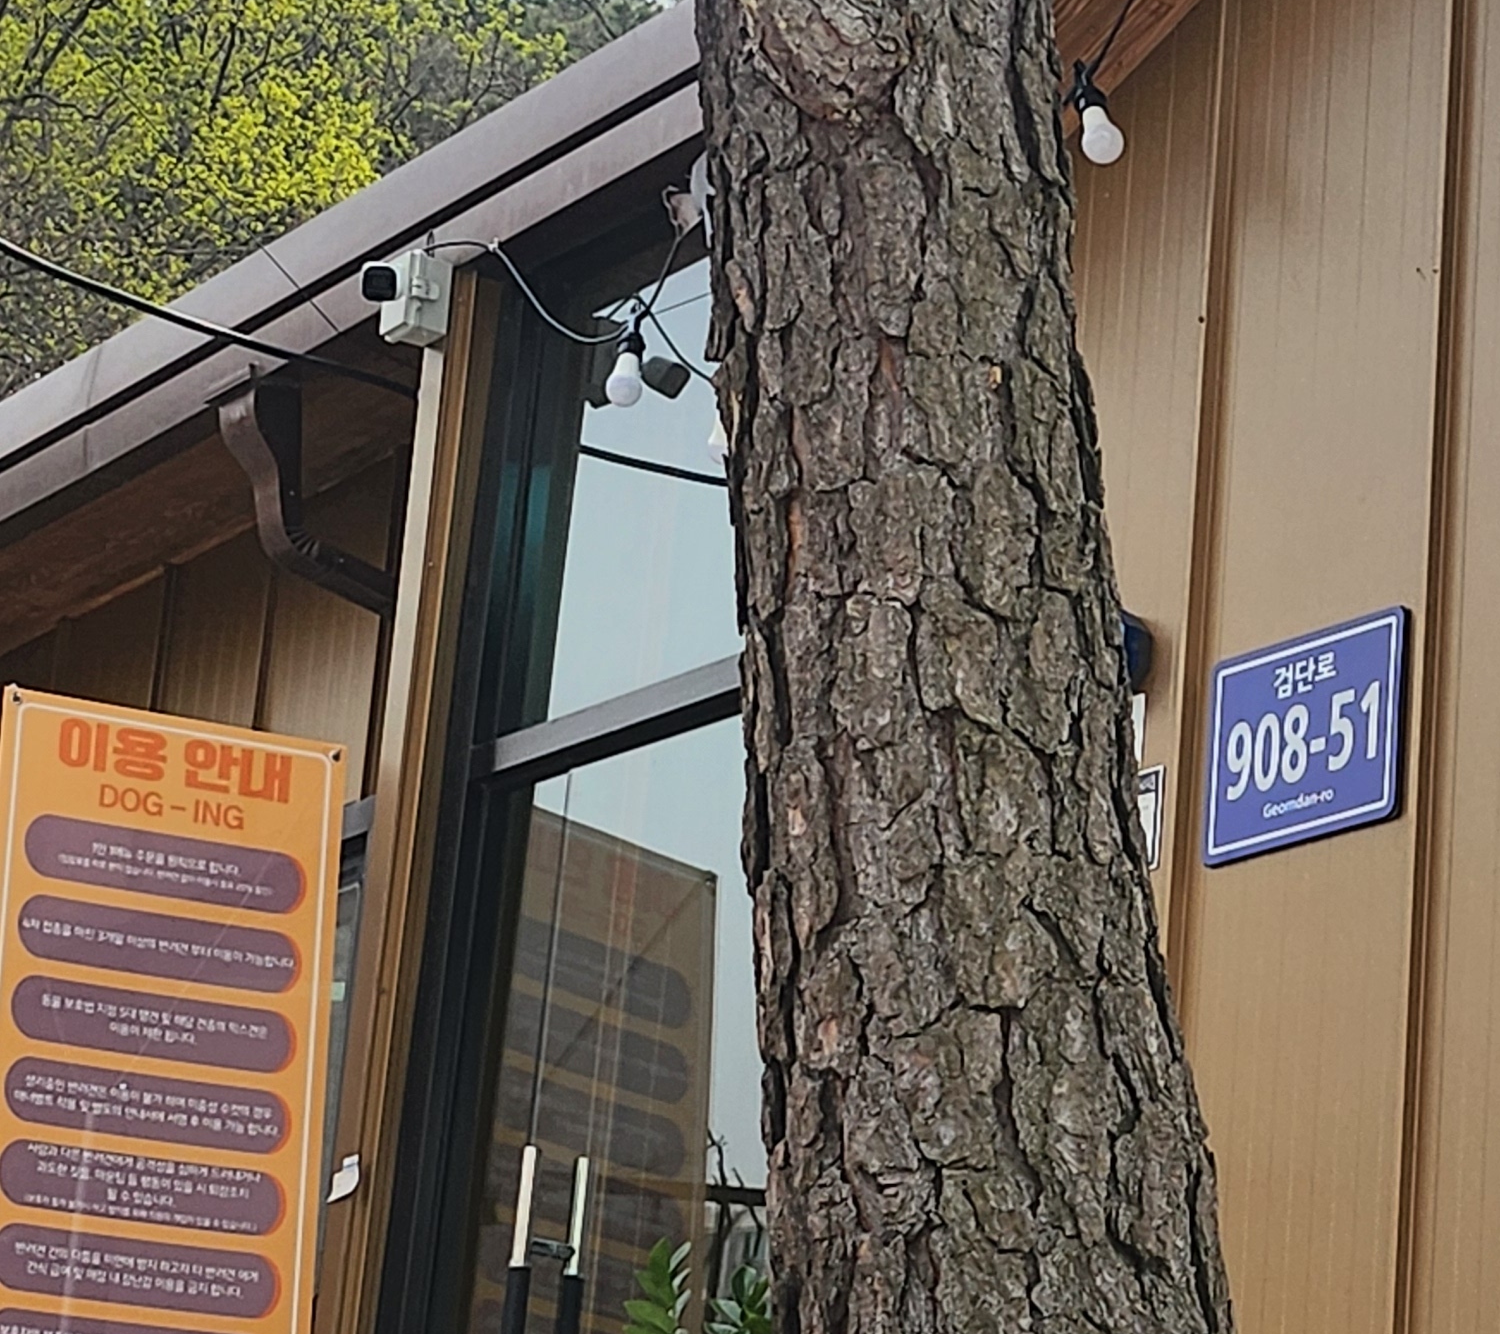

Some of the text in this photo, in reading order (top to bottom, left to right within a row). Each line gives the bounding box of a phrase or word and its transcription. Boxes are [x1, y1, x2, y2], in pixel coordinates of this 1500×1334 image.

[1272, 651, 1337, 699] 검단로
[58, 718, 293, 804] 이용 안내
[1226, 680, 1381, 801] 908-51
[1262, 788, 1335, 818] Geomdan-ro
